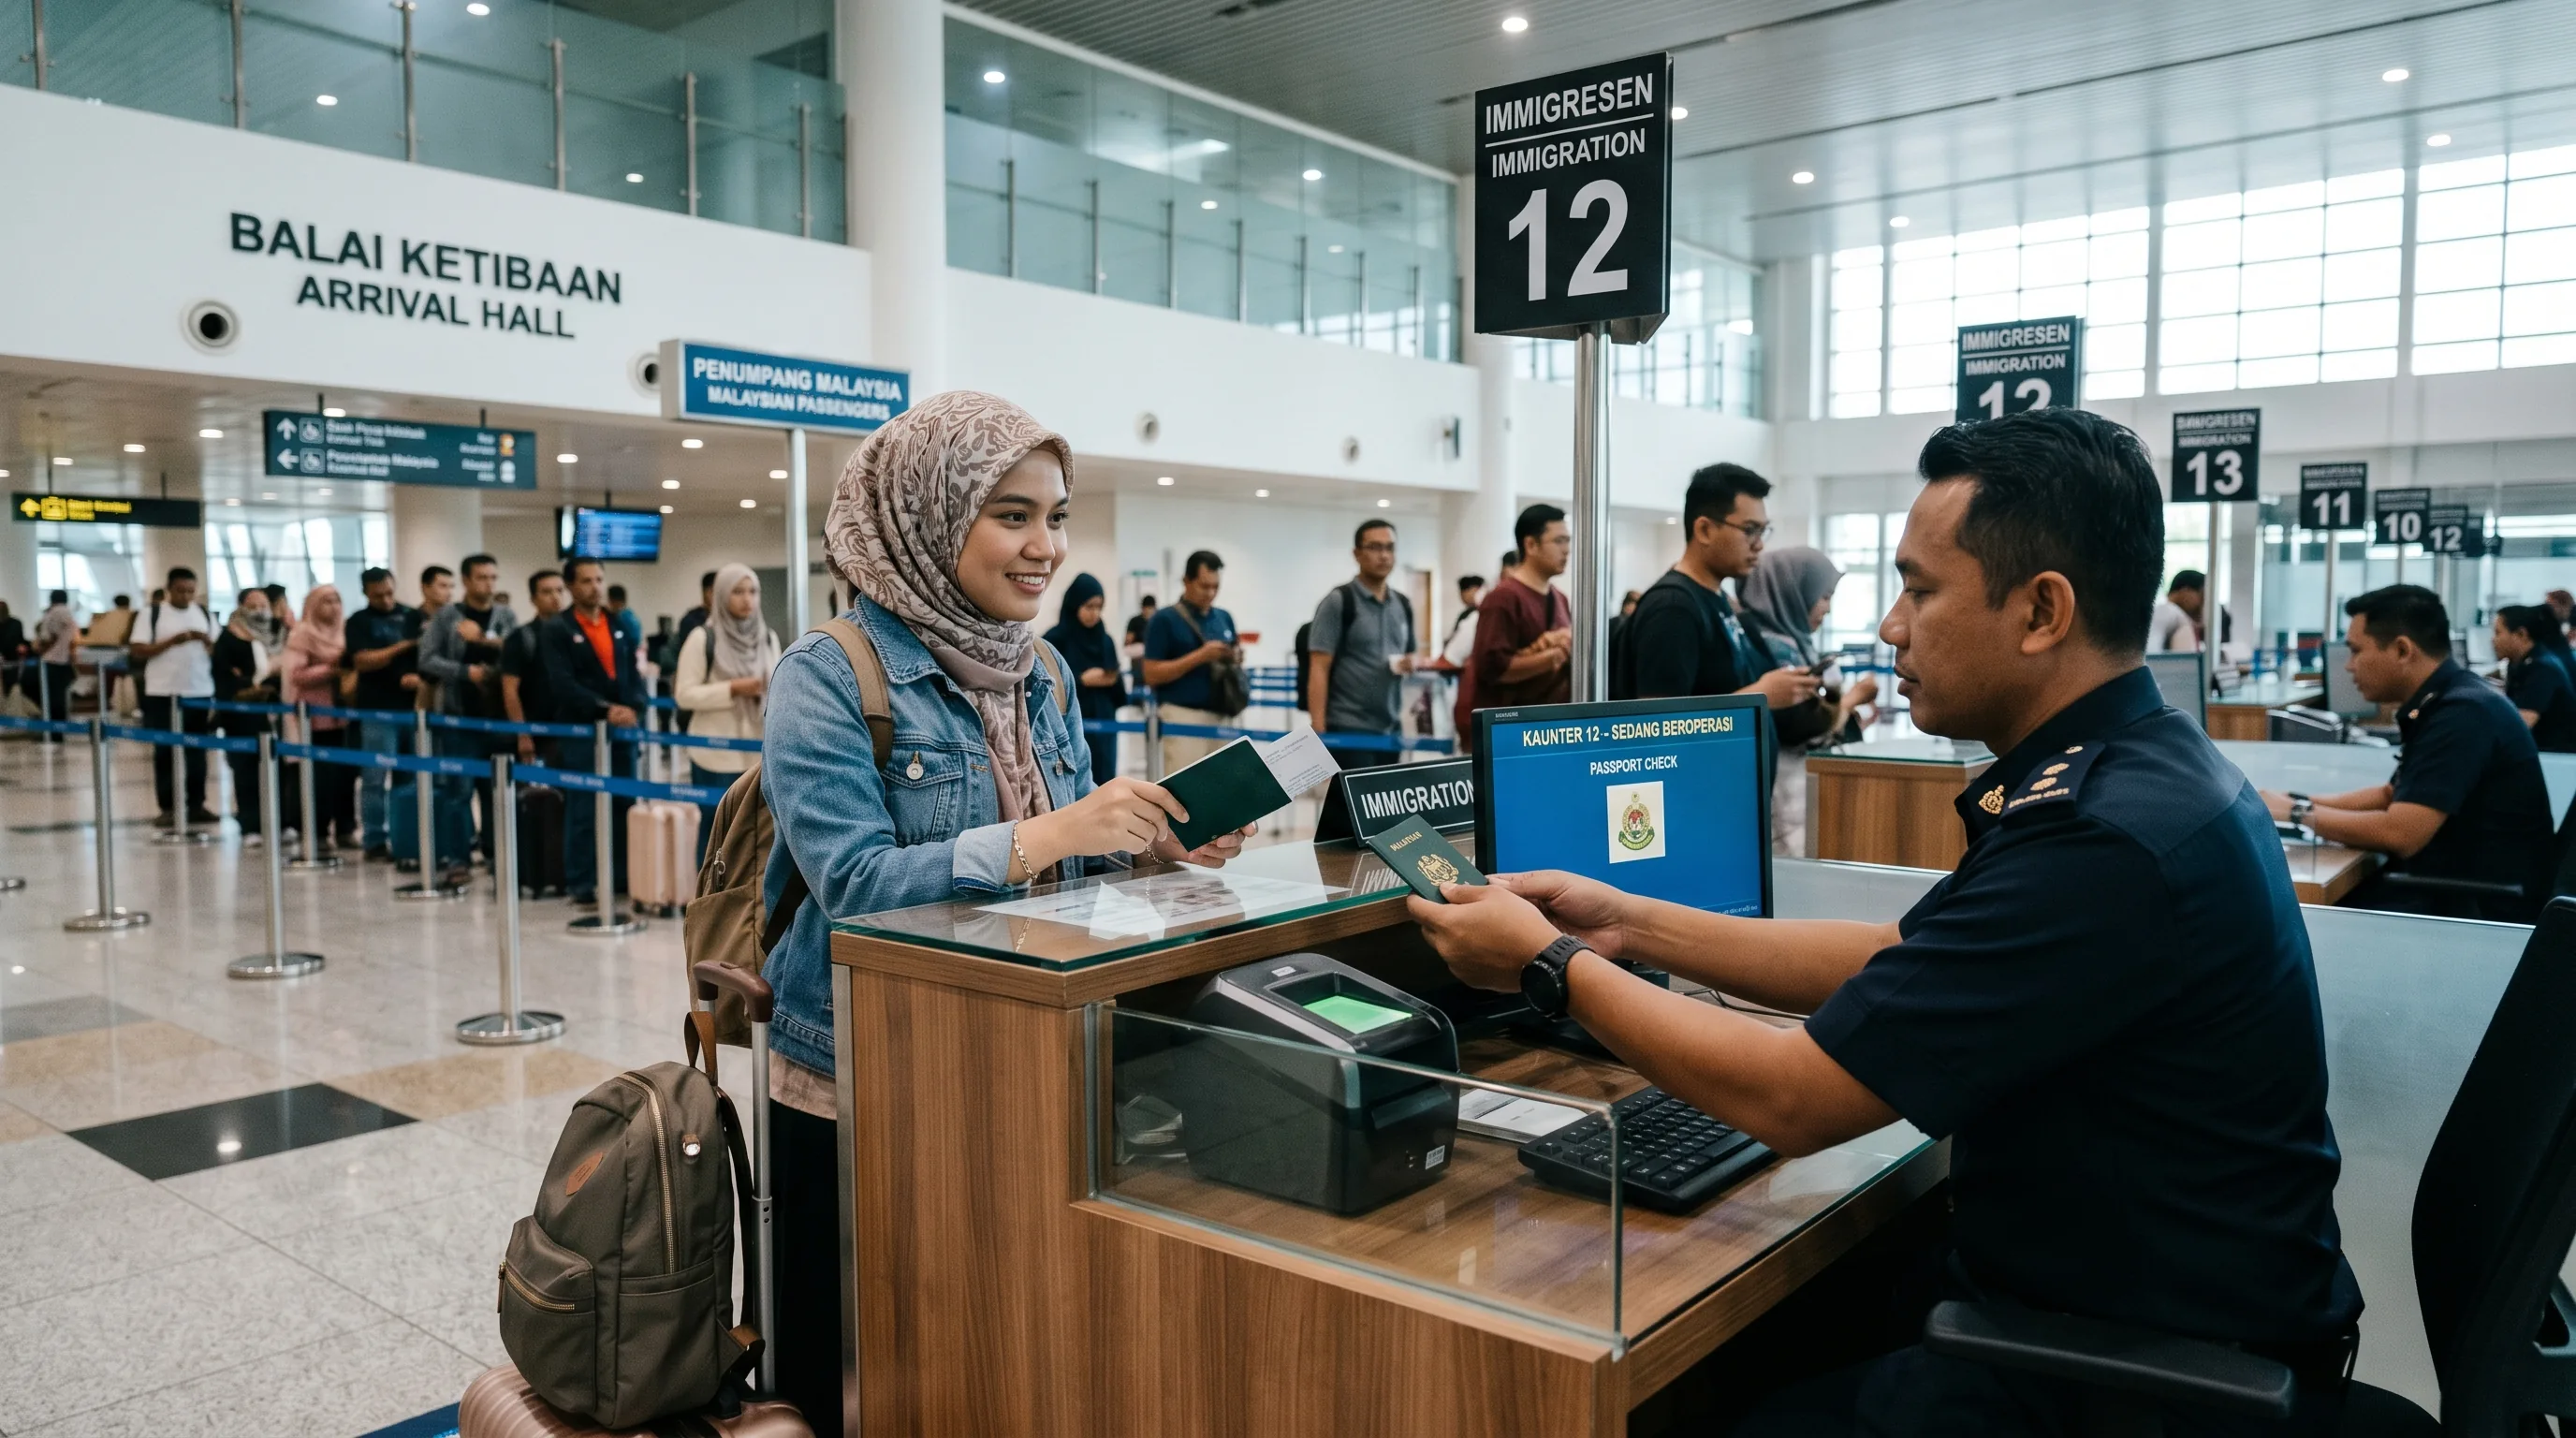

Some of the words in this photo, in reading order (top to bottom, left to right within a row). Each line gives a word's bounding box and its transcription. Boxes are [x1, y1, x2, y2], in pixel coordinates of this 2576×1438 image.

[1486, 73, 1653, 134] IMMIGRESEN
[1492, 128, 1646, 178] IMMIGRATION
[1508, 179, 1629, 301] 12
[230, 213, 383, 271] BALAI
[401, 239, 621, 304] KETIBAAN
[297, 276, 470, 325] ARRIVAL
[482, 301, 576, 338] HALL
[1962, 323, 2071, 351] IMMIGRESEN
[693, 357, 812, 391] PENUMPANG
[815, 372, 903, 402] MALAYSIA
[1966, 354, 2067, 375] IMMIGRATION
[708, 385, 796, 411] MALAYSIAN
[797, 394, 891, 421] PASSENGERS
[2187, 449, 2244, 496] 13
[2312, 491, 2351, 526] 11
[2383, 511, 2422, 542] 10
[2429, 525, 2463, 551] 12
[1523, 726, 1583, 747] KAUNTER
[1586, 726, 1600, 742] 12
[1612, 721, 1660, 741] SEDANG
[1662, 716, 1734, 737] BEROPERASI
[1590, 757, 1642, 776] PASSPORT
[1645, 756, 1678, 770] CHECK
